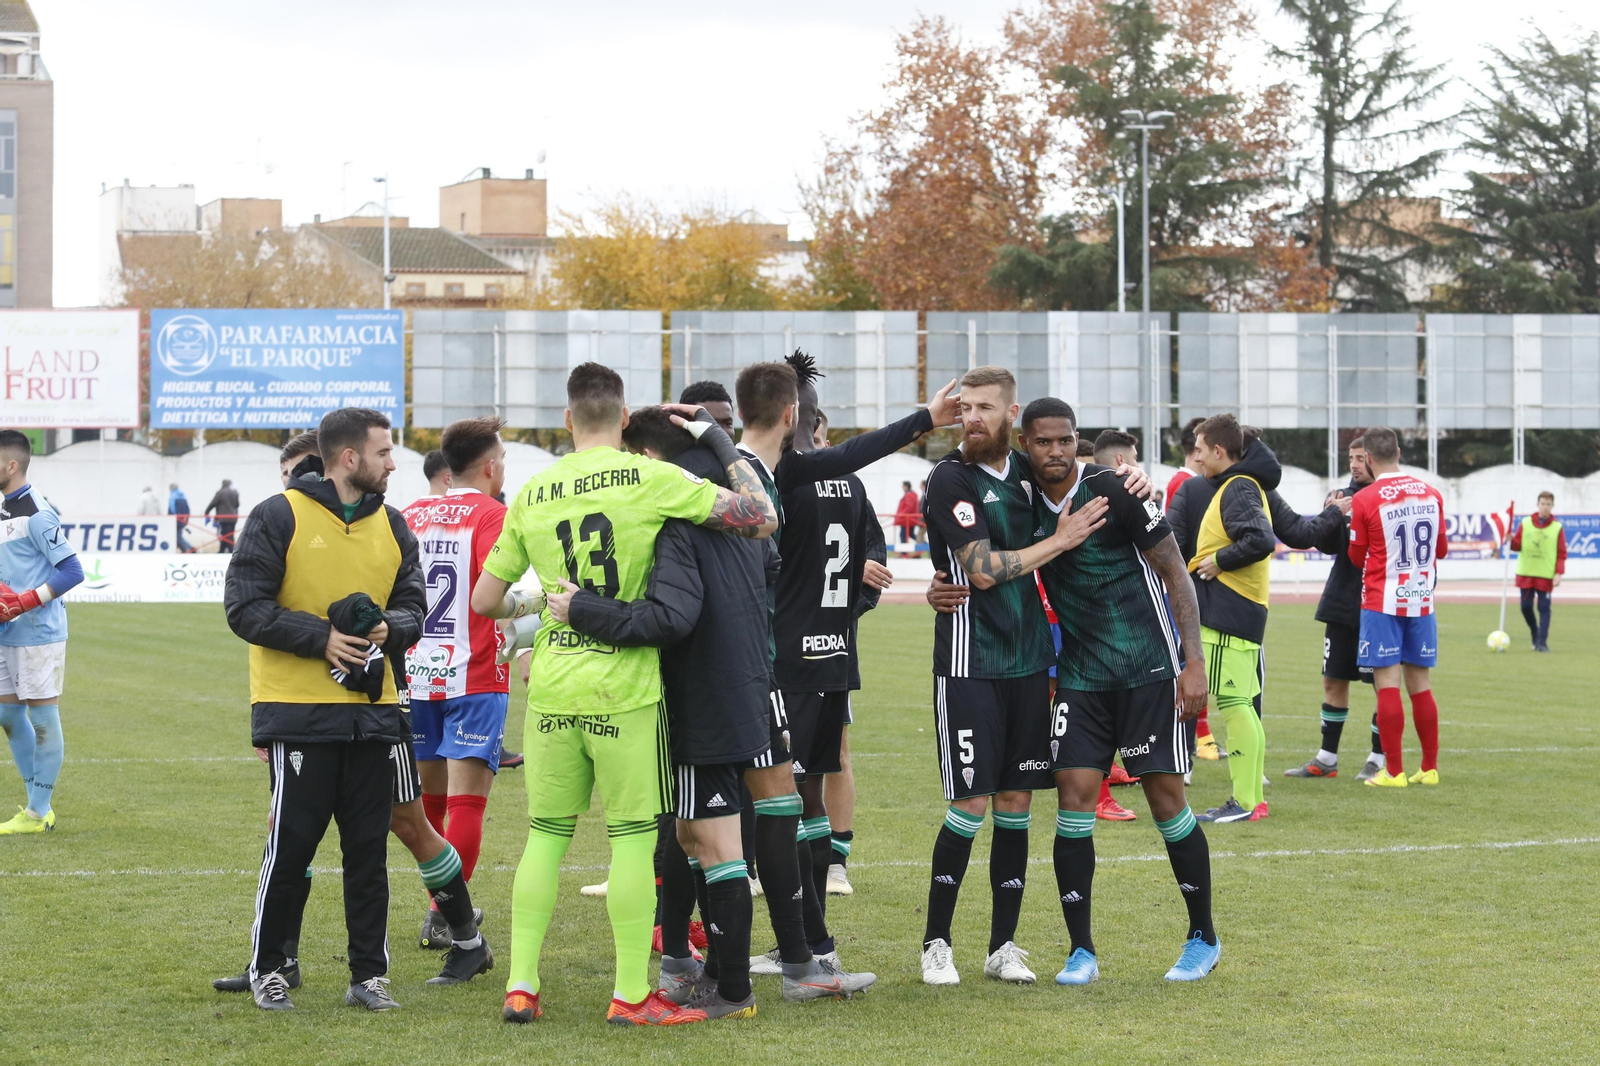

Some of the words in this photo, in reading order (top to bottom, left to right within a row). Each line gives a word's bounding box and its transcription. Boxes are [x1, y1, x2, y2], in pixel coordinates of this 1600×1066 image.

[220, 325, 398, 345] PARAFARMACIA
[5, 345, 99, 373] LAND
[4, 372, 100, 400] FRUIT
[162, 381, 213, 393] HIGIENE
[215, 381, 256, 393] BUCAL
[267, 381, 323, 393] CUIDADO
[325, 381, 392, 393] CORPORAL
[156, 396, 233, 408] PRODUCTOS
[235, 397, 246, 408] Y
[246, 393, 341, 408] ALIMENTACIÓN
[342, 396, 398, 408] INFANTIL
[161, 408, 230, 423] DIETÉTICA
[231, 412, 242, 423] Y
[243, 408, 313, 423] NUTRICIÓN
[574, 468, 641, 495] BECERRA
[1387, 506, 1410, 520] DANI
[1412, 504, 1436, 515] LOPEZ
[422, 540, 460, 555] NIETO
[555, 512, 620, 600] 13
[1394, 518, 1434, 568] 18
[821, 523, 850, 608] 2
[422, 560, 458, 639] 2
[958, 729, 975, 764] 5
[1019, 759, 1050, 771] effico
